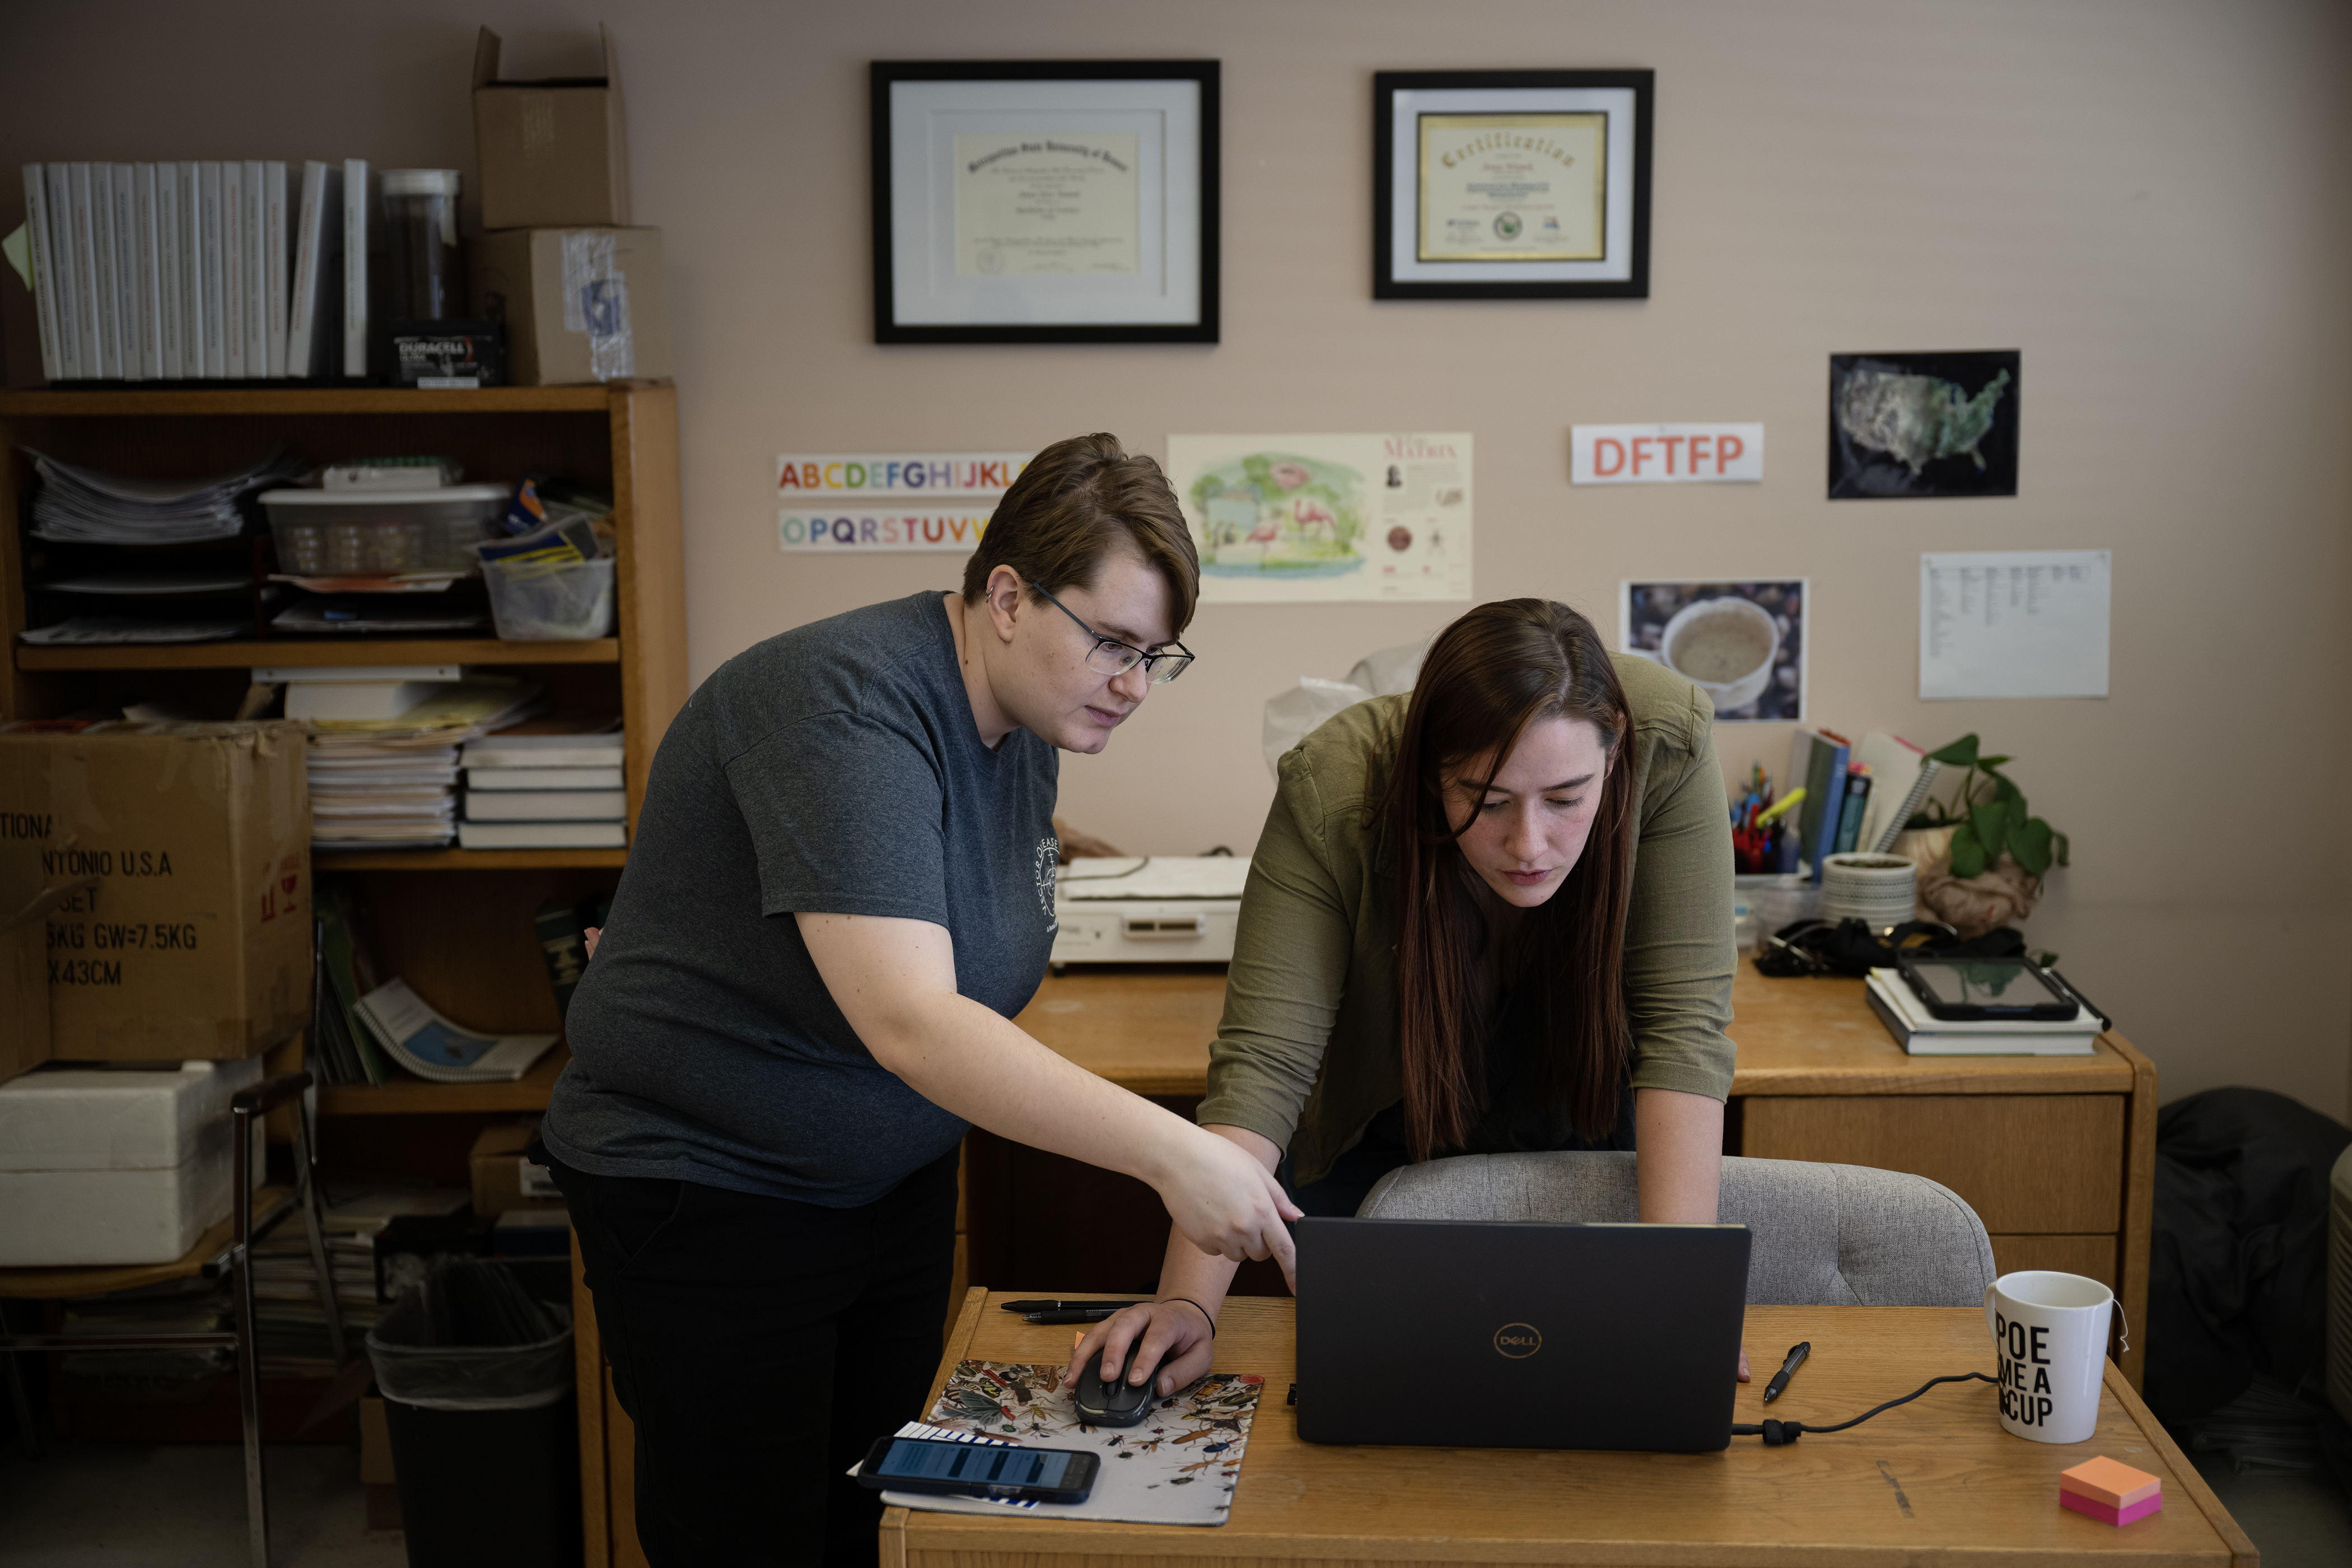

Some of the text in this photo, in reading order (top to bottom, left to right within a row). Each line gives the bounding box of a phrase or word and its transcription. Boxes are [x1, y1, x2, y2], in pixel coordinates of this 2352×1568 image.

[399, 342, 465, 355] DURACELL
[1594, 435, 1744, 477] DFTFP
[0, 813, 62, 839] TIONA
[94, 923, 197, 950] GW=7.5KG
[47, 959, 122, 986] X43CM
[1500, 1336, 1537, 1346] DELL
[1996, 1310, 2051, 1365] POE
[1999, 1353, 2051, 1395] ME A
[2008, 1389, 2053, 1427] CUP
